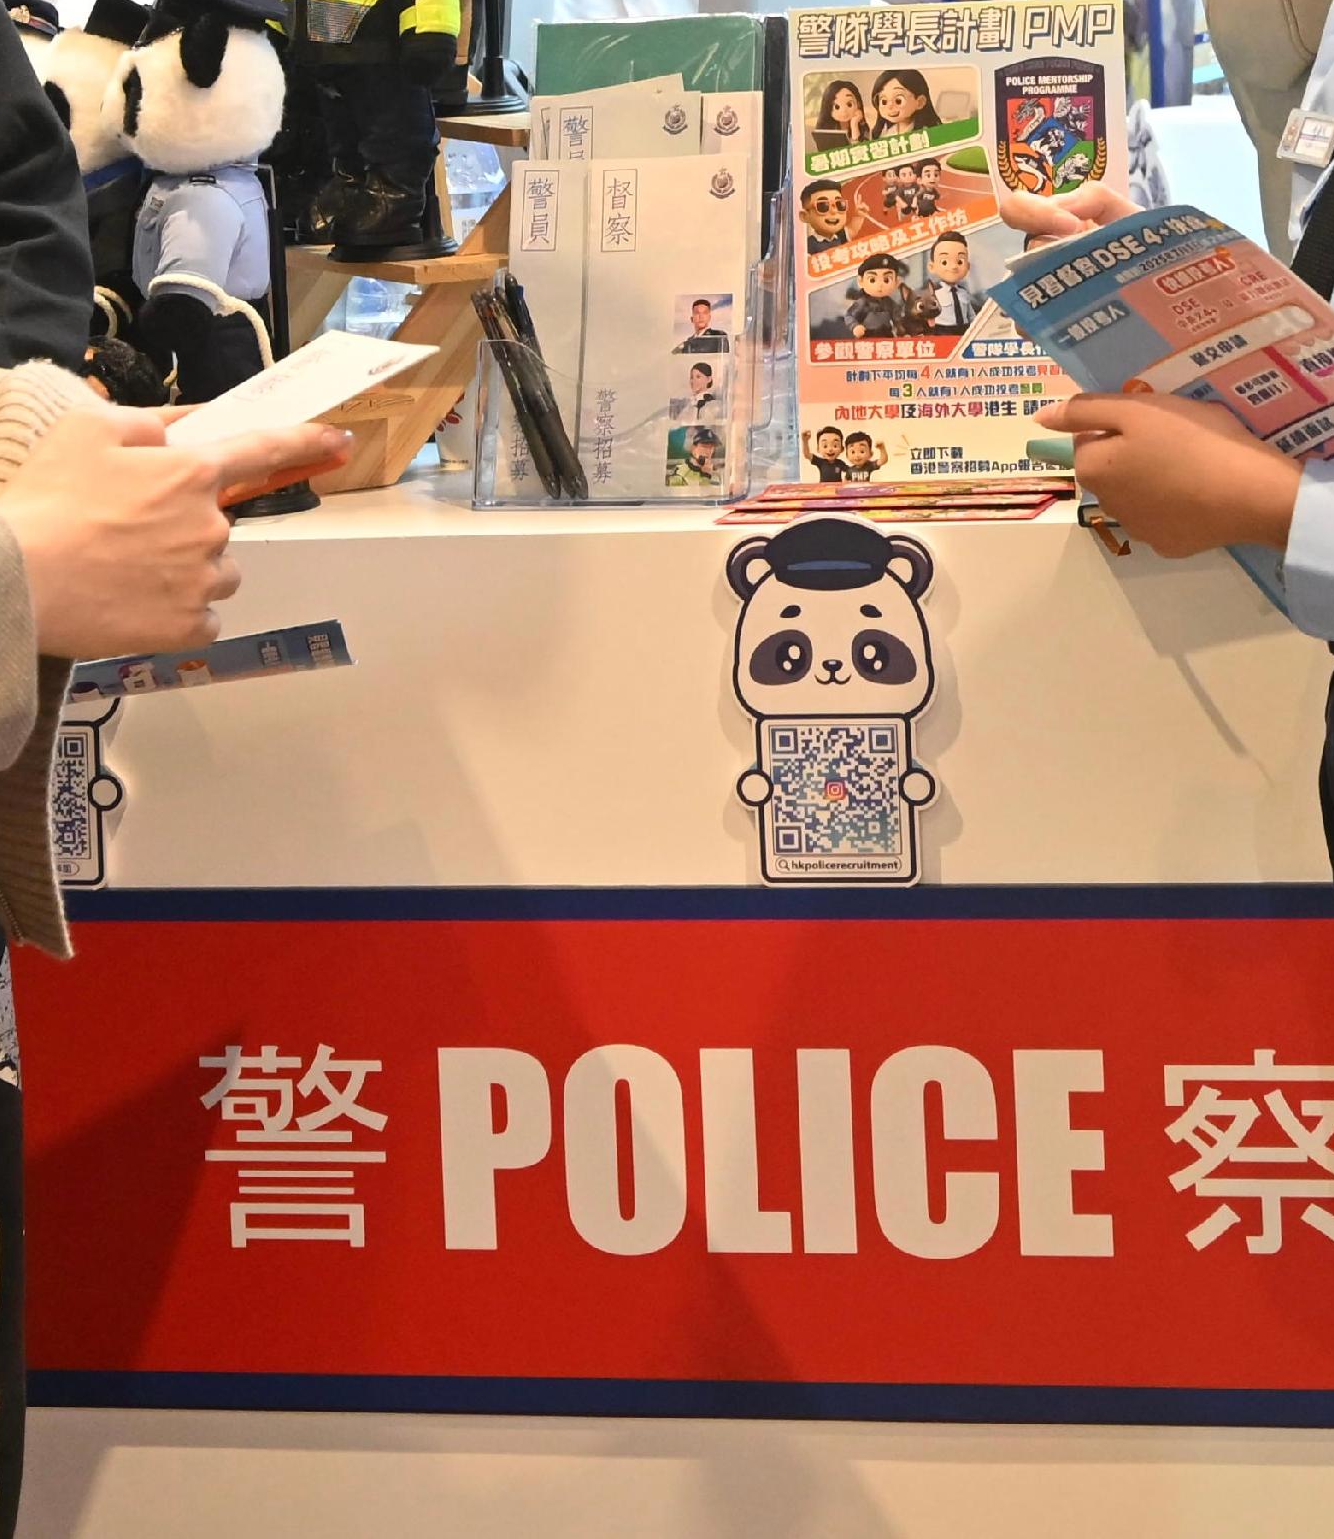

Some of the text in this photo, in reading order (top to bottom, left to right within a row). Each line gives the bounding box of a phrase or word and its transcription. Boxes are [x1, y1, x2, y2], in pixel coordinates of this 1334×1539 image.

[798, 4, 1115, 58] 警隊學長計劃 PMP
[1005, 73, 1094, 86] POLICE MENTORSHIP
[1022, 83, 1079, 95] PROGRAMME
[810, 132, 931, 173] 暑期實習計劃
[527, 177, 556, 245] 警員
[606, 177, 636, 245] 督察
[811, 208, 968, 273] 投考攻略及工作坊
[814, 340, 936, 361] 參觀警察單位
[791, 859, 898, 872] hkpolicerecruitment
[199, 1043, 390, 1249] 警
[436, 1042, 1115, 1260] POLICE
